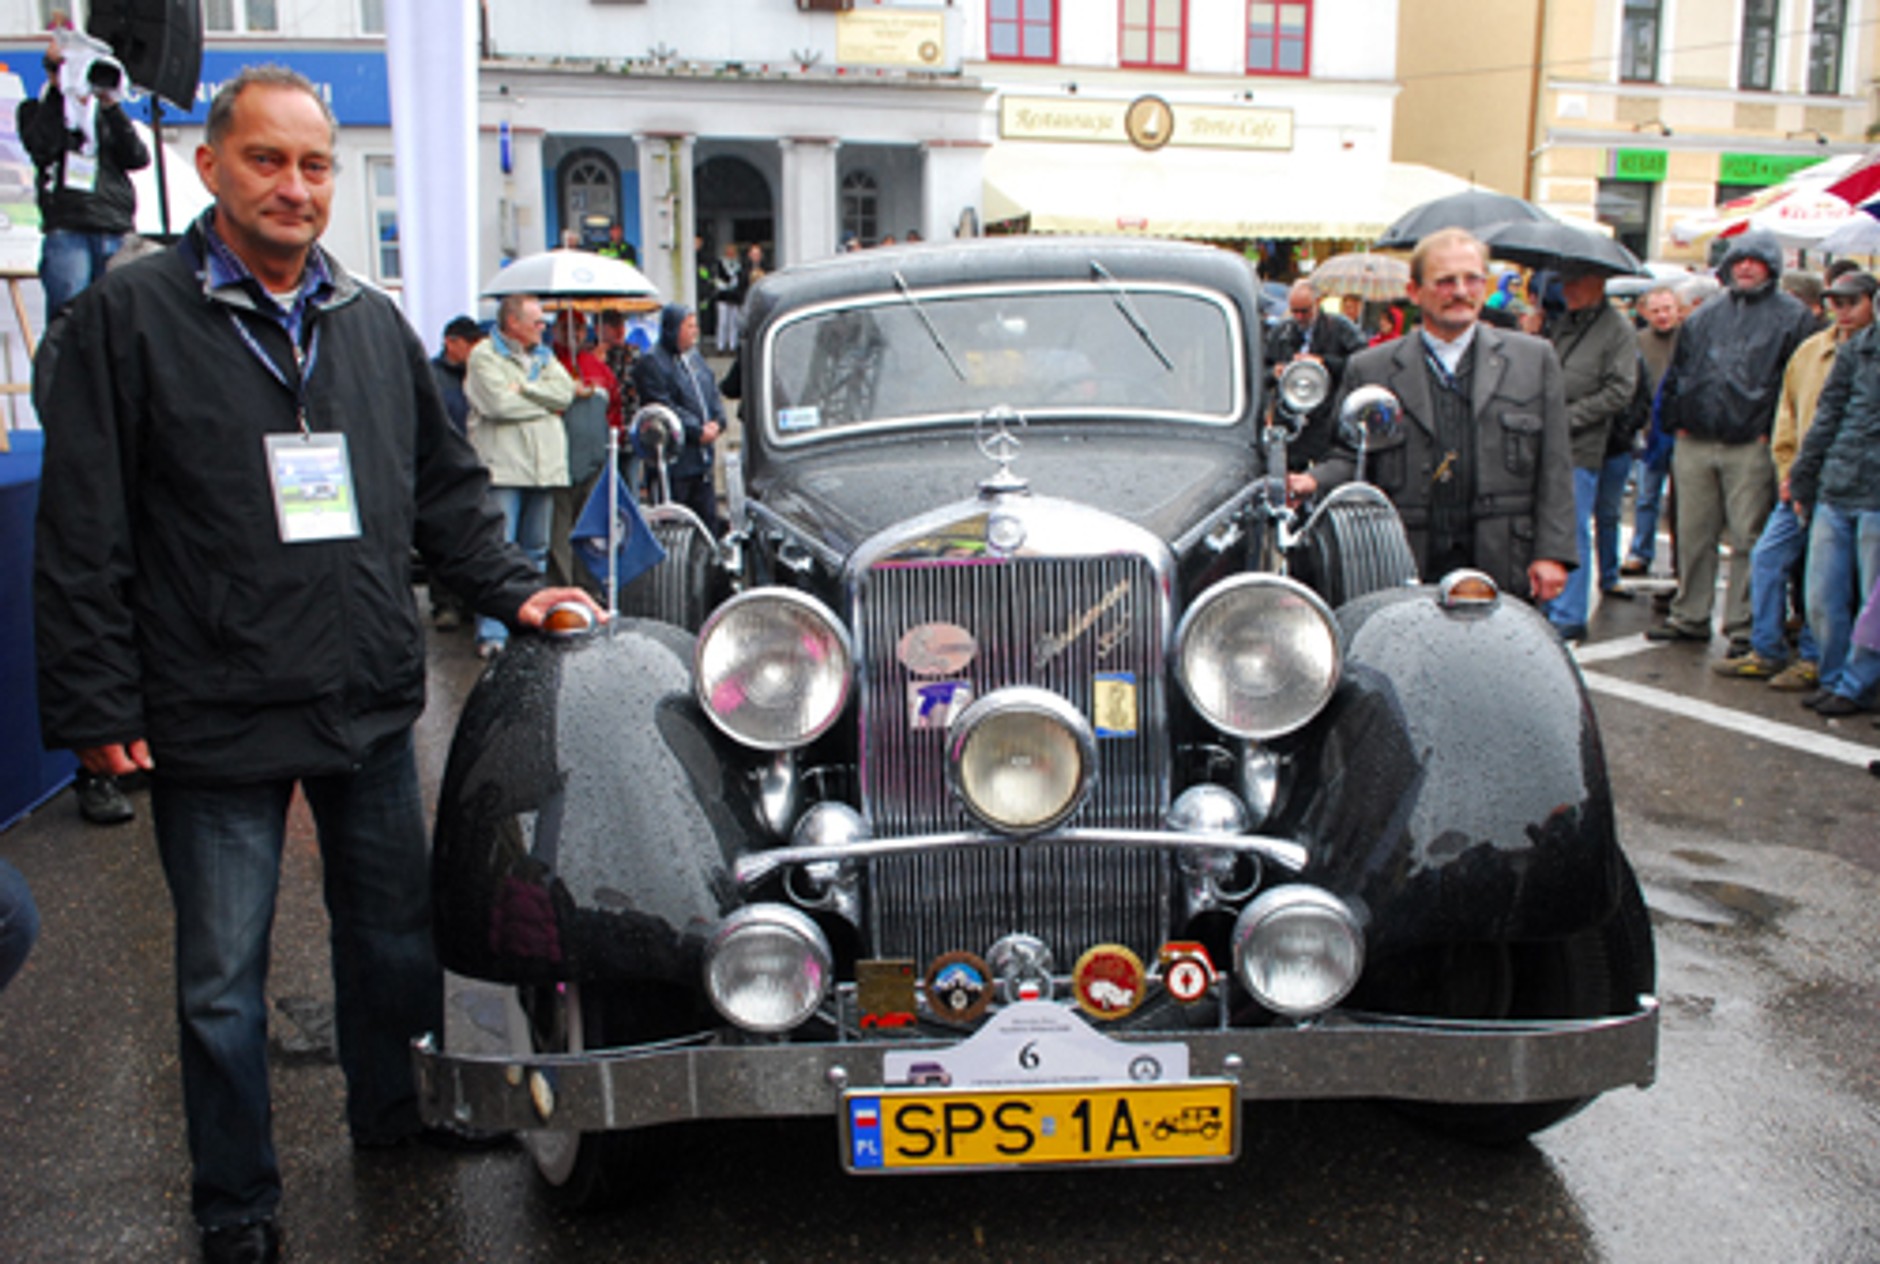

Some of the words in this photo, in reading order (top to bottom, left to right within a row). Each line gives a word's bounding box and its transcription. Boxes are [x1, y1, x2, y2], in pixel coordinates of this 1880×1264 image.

[1018, 1041, 1040, 1070] 6
[894, 1100, 1036, 1159] SPS
[1071, 1098, 1141, 1153] 1A
[857, 1139, 878, 1156] PL
